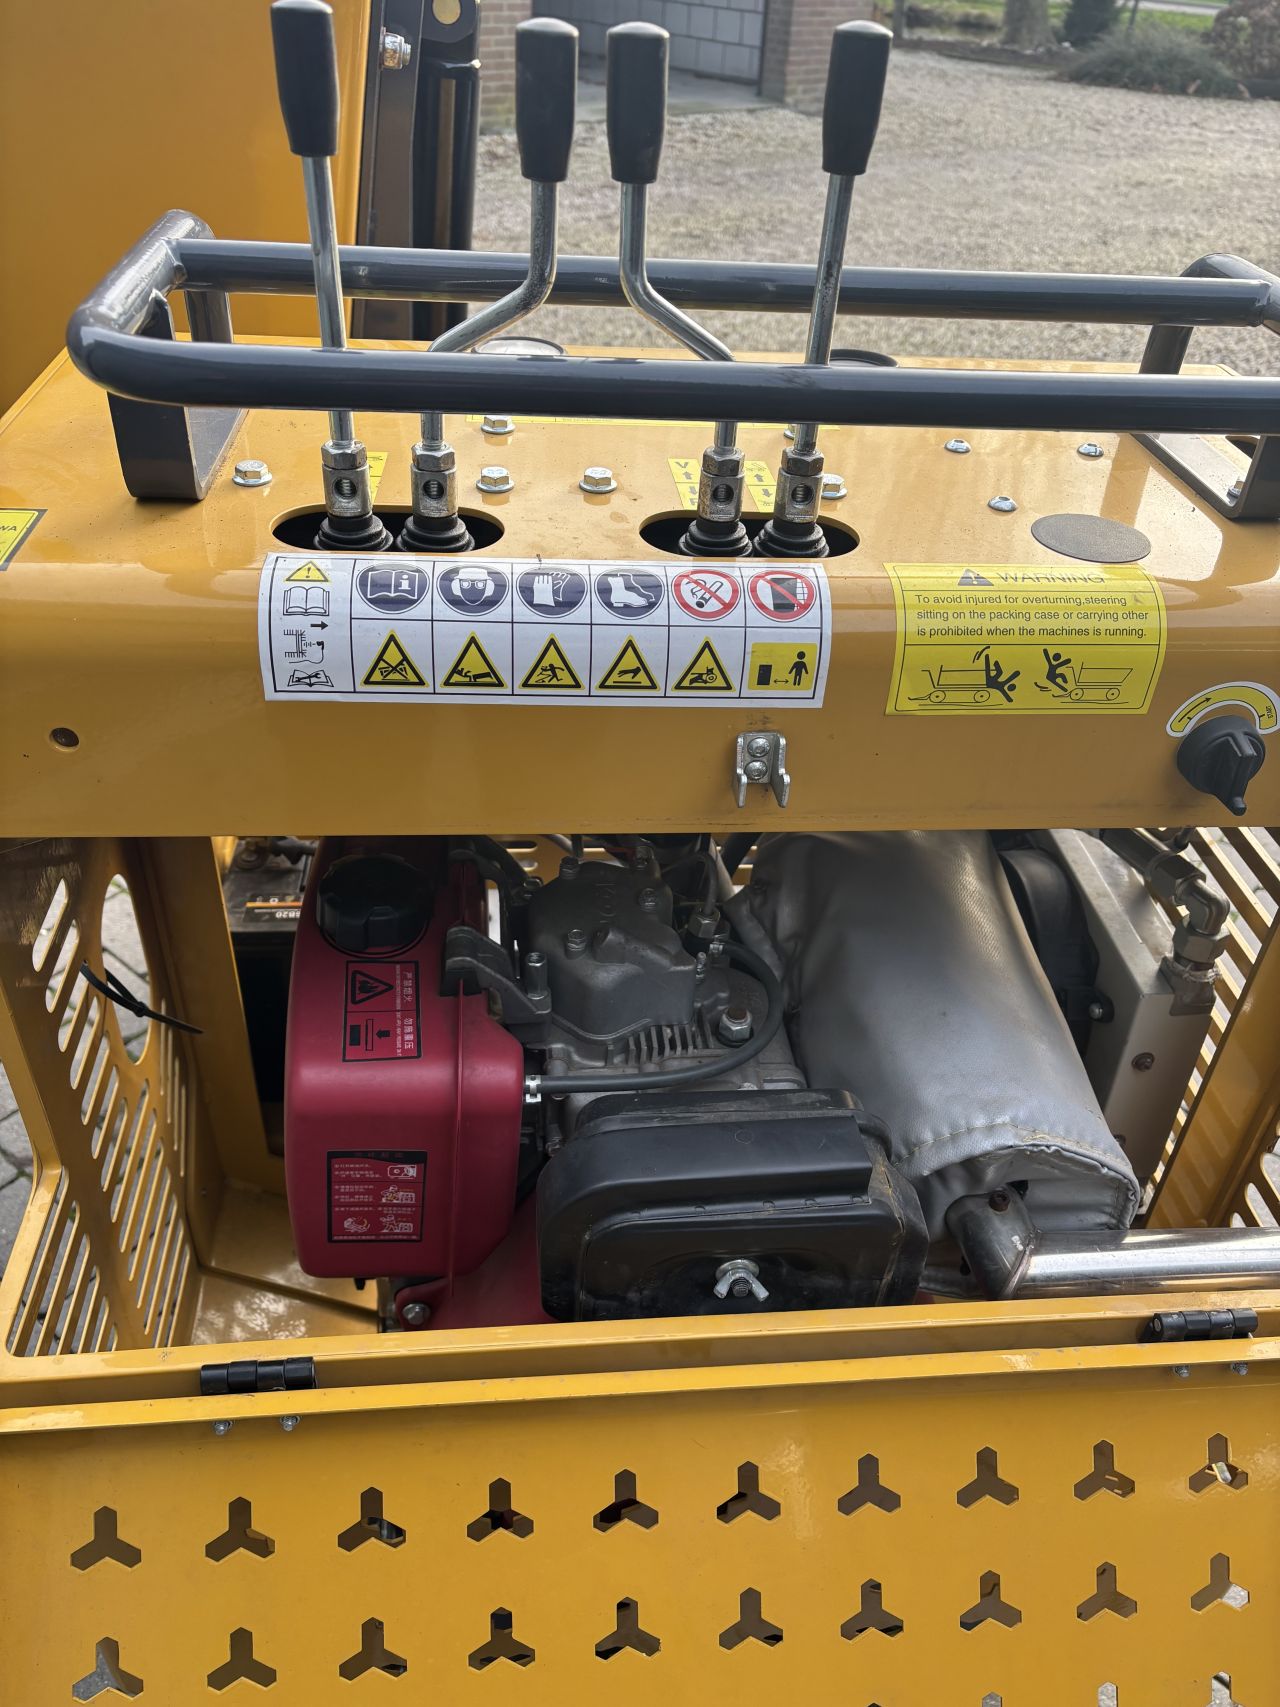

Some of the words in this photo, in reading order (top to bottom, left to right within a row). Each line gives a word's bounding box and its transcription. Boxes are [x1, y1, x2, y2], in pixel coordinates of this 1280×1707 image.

[996, 572, 1105, 583] WARNING
[915, 594, 930, 604] To
[933, 594, 962, 604] avoid
[965, 594, 1001, 606] injured
[1004, 594, 1018, 604] for
[917, 609, 949, 621] sitting
[952, 611, 965, 620] on
[969, 610, 986, 620] the
[989, 609, 1031, 621] packing
[1034, 611, 1060, 620] case
[1063, 611, 1074, 620] or
[1076, 610, 1119, 621] carrying
[1121, 610, 1148, 620] other
[917, 625, 926, 636] is
[929, 625, 983, 638] prohibited
[986, 626, 1015, 636] when
[1018, 626, 1035, 636] the
[1038, 626, 1090, 636] machines
[1093, 626, 1101, 637] is
[1105, 626, 1146, 639] running.
